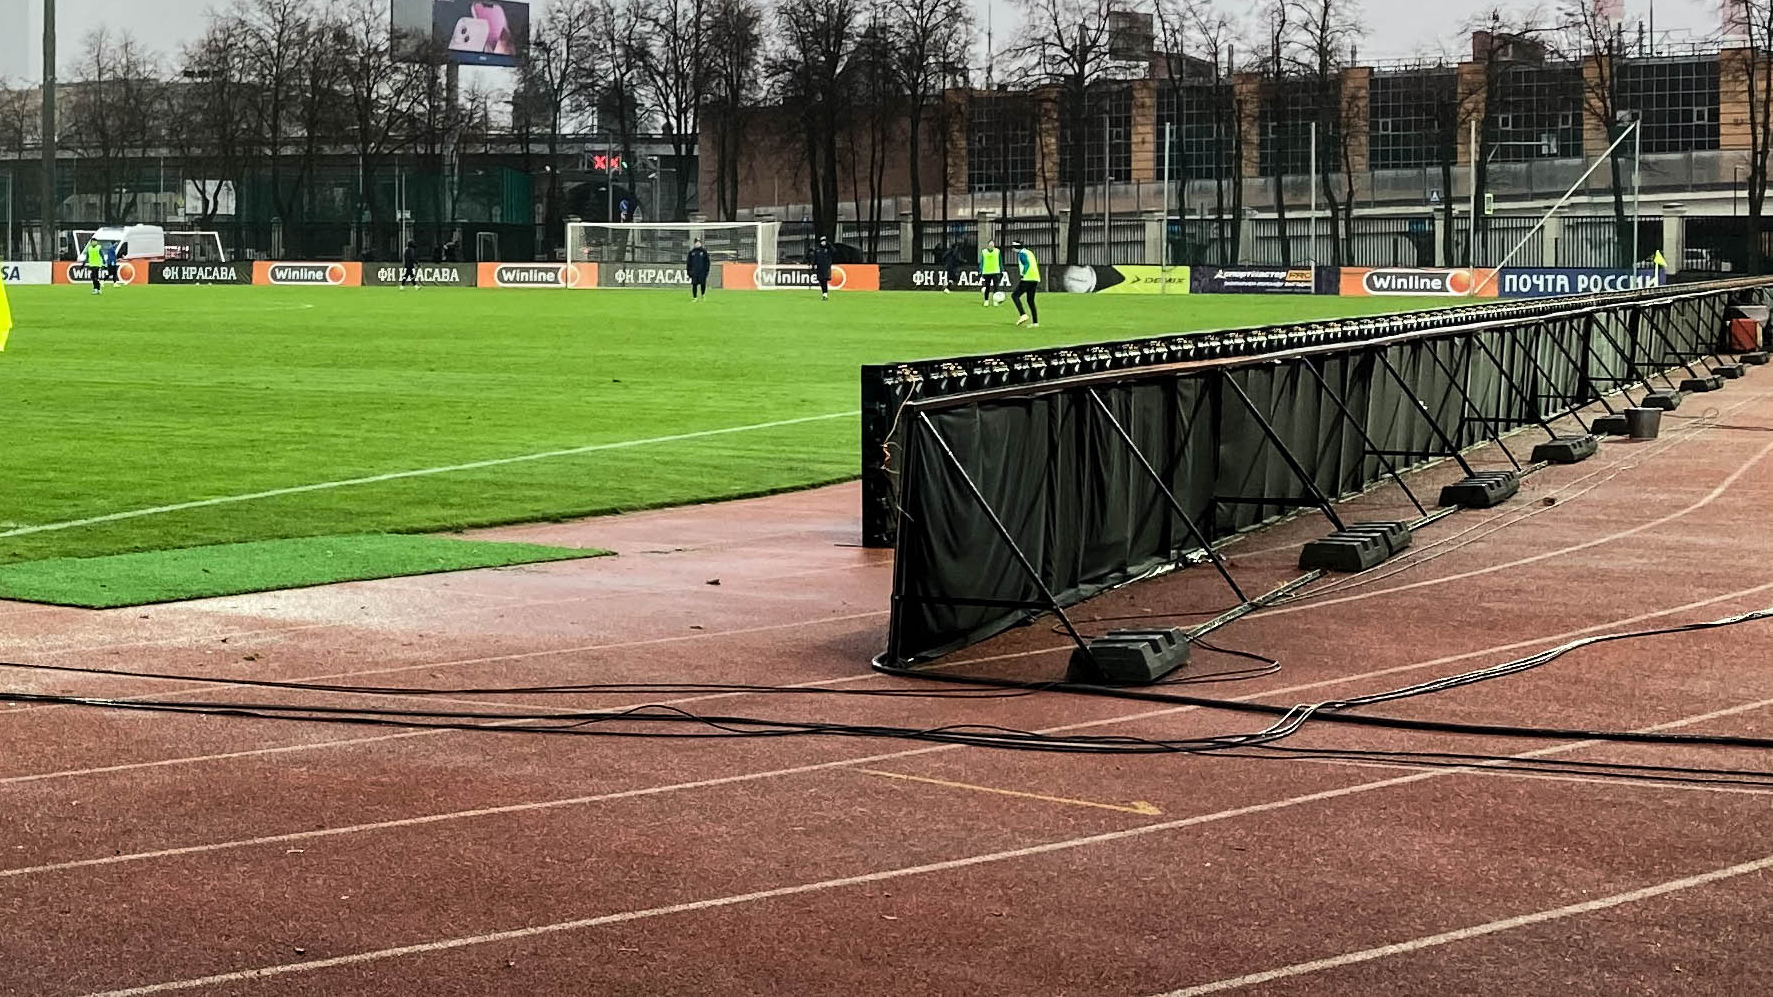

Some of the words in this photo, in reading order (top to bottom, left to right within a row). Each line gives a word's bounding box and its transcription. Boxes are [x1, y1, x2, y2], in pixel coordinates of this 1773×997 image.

[1, 266, 20, 280] SA
[275, 267, 324, 281] Winline
[501, 268, 555, 282] Winline
[761, 270, 820, 284] Winline
[1372, 274, 1442, 289] Winline
[1504, 274, 1570, 293] ПОЧТА
